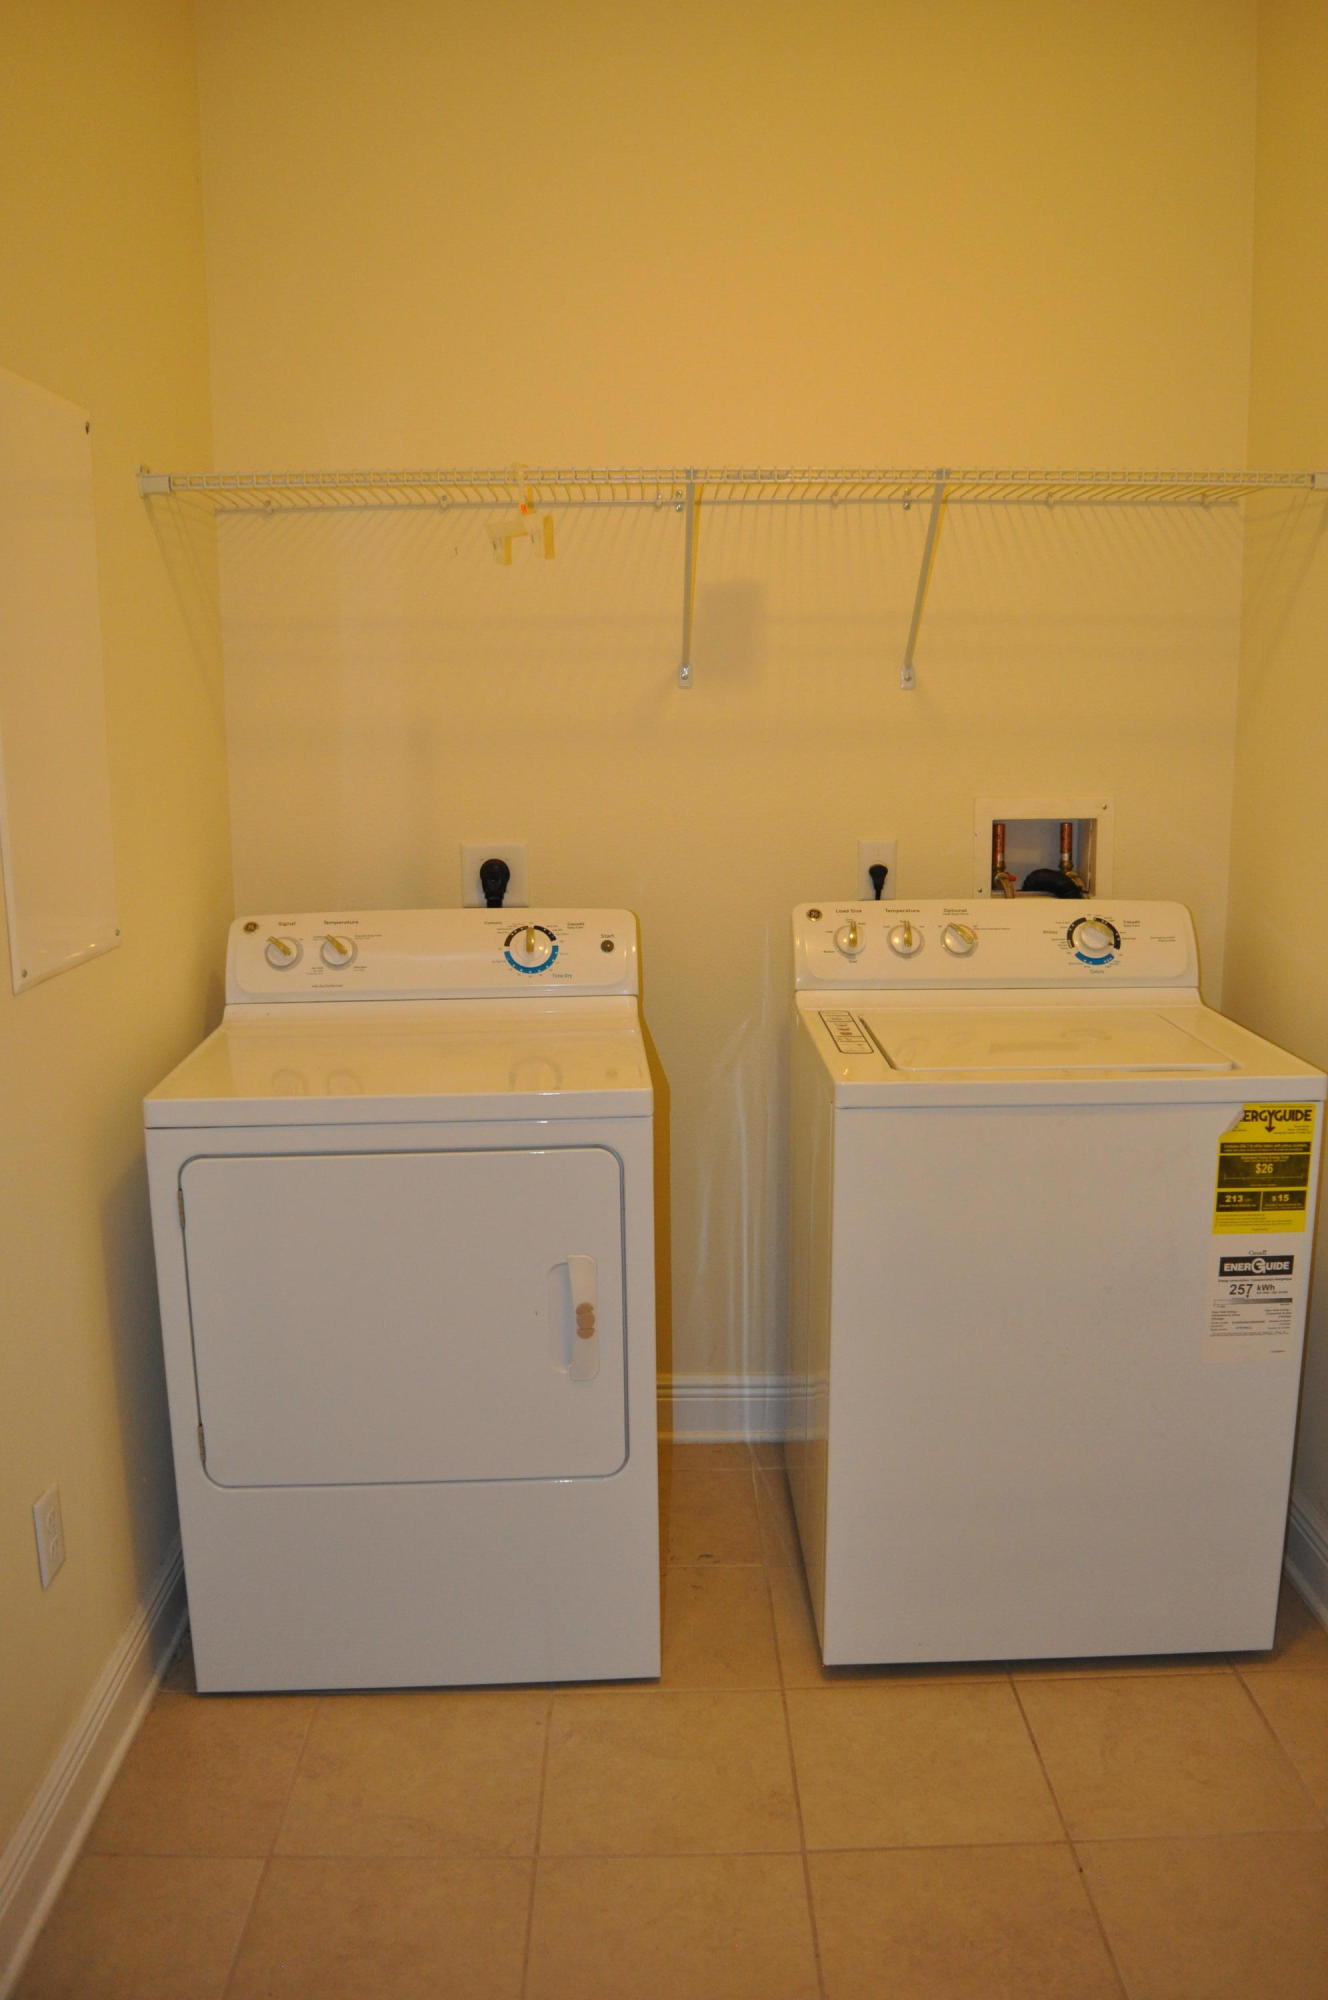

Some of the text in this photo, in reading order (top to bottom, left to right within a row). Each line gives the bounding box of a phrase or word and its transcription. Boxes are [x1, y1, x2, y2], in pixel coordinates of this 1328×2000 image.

[1241, 1109, 1313, 1122] ERGYGUIDE
[1255, 1163, 1274, 1174] $26
[1224, 1194, 1244, 1203] 213
[1224, 1258, 1290, 1274] ENERGUIDE
[1229, 1284, 1253, 1296] 257
